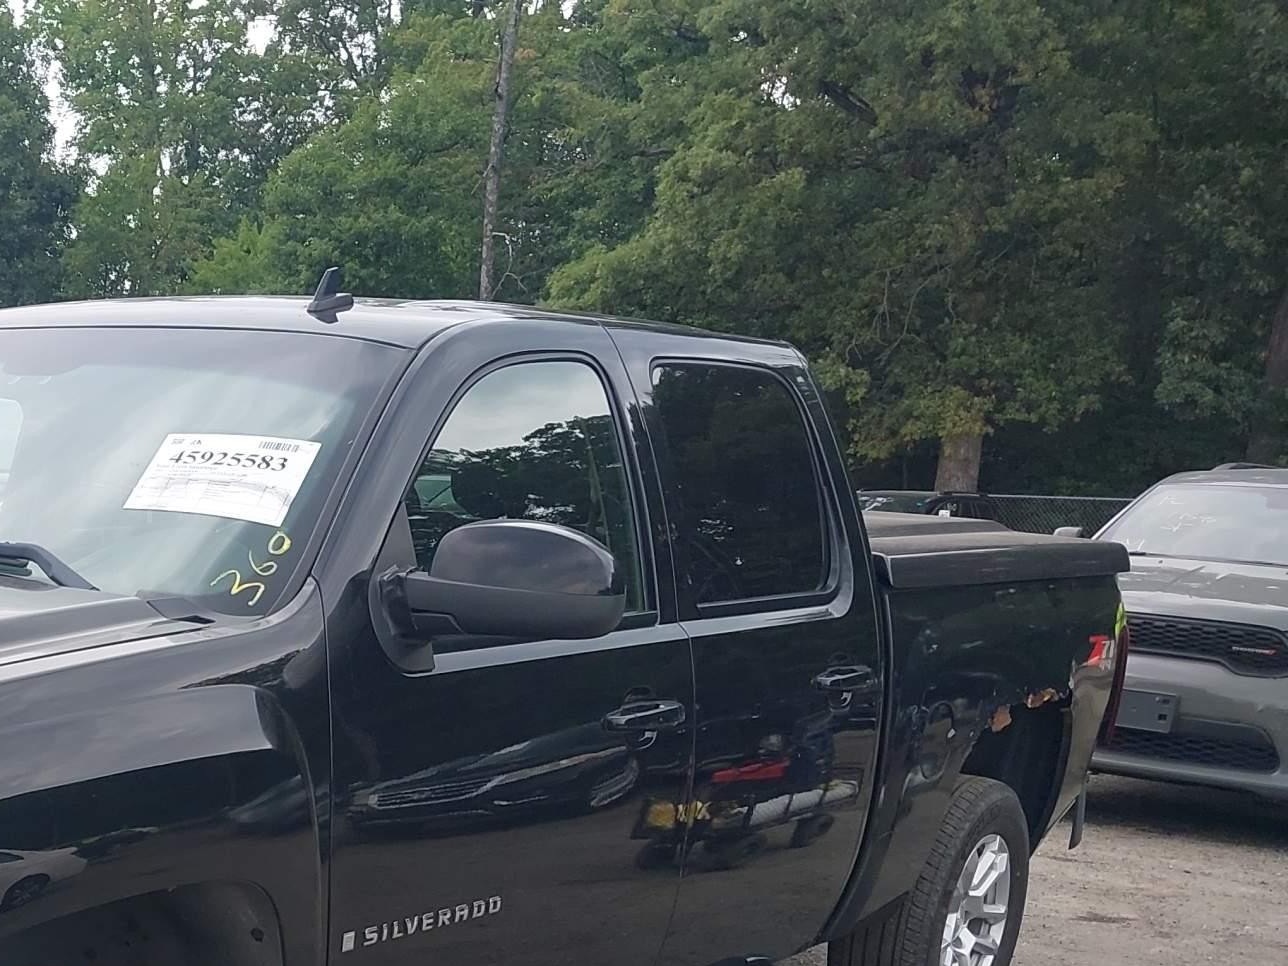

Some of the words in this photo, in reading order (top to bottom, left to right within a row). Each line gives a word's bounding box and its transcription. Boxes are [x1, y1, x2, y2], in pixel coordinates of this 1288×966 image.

[169, 450, 288, 472] 45925583
[210, 531, 292, 606] 360
[363, 895, 502, 946] SILVERADO
